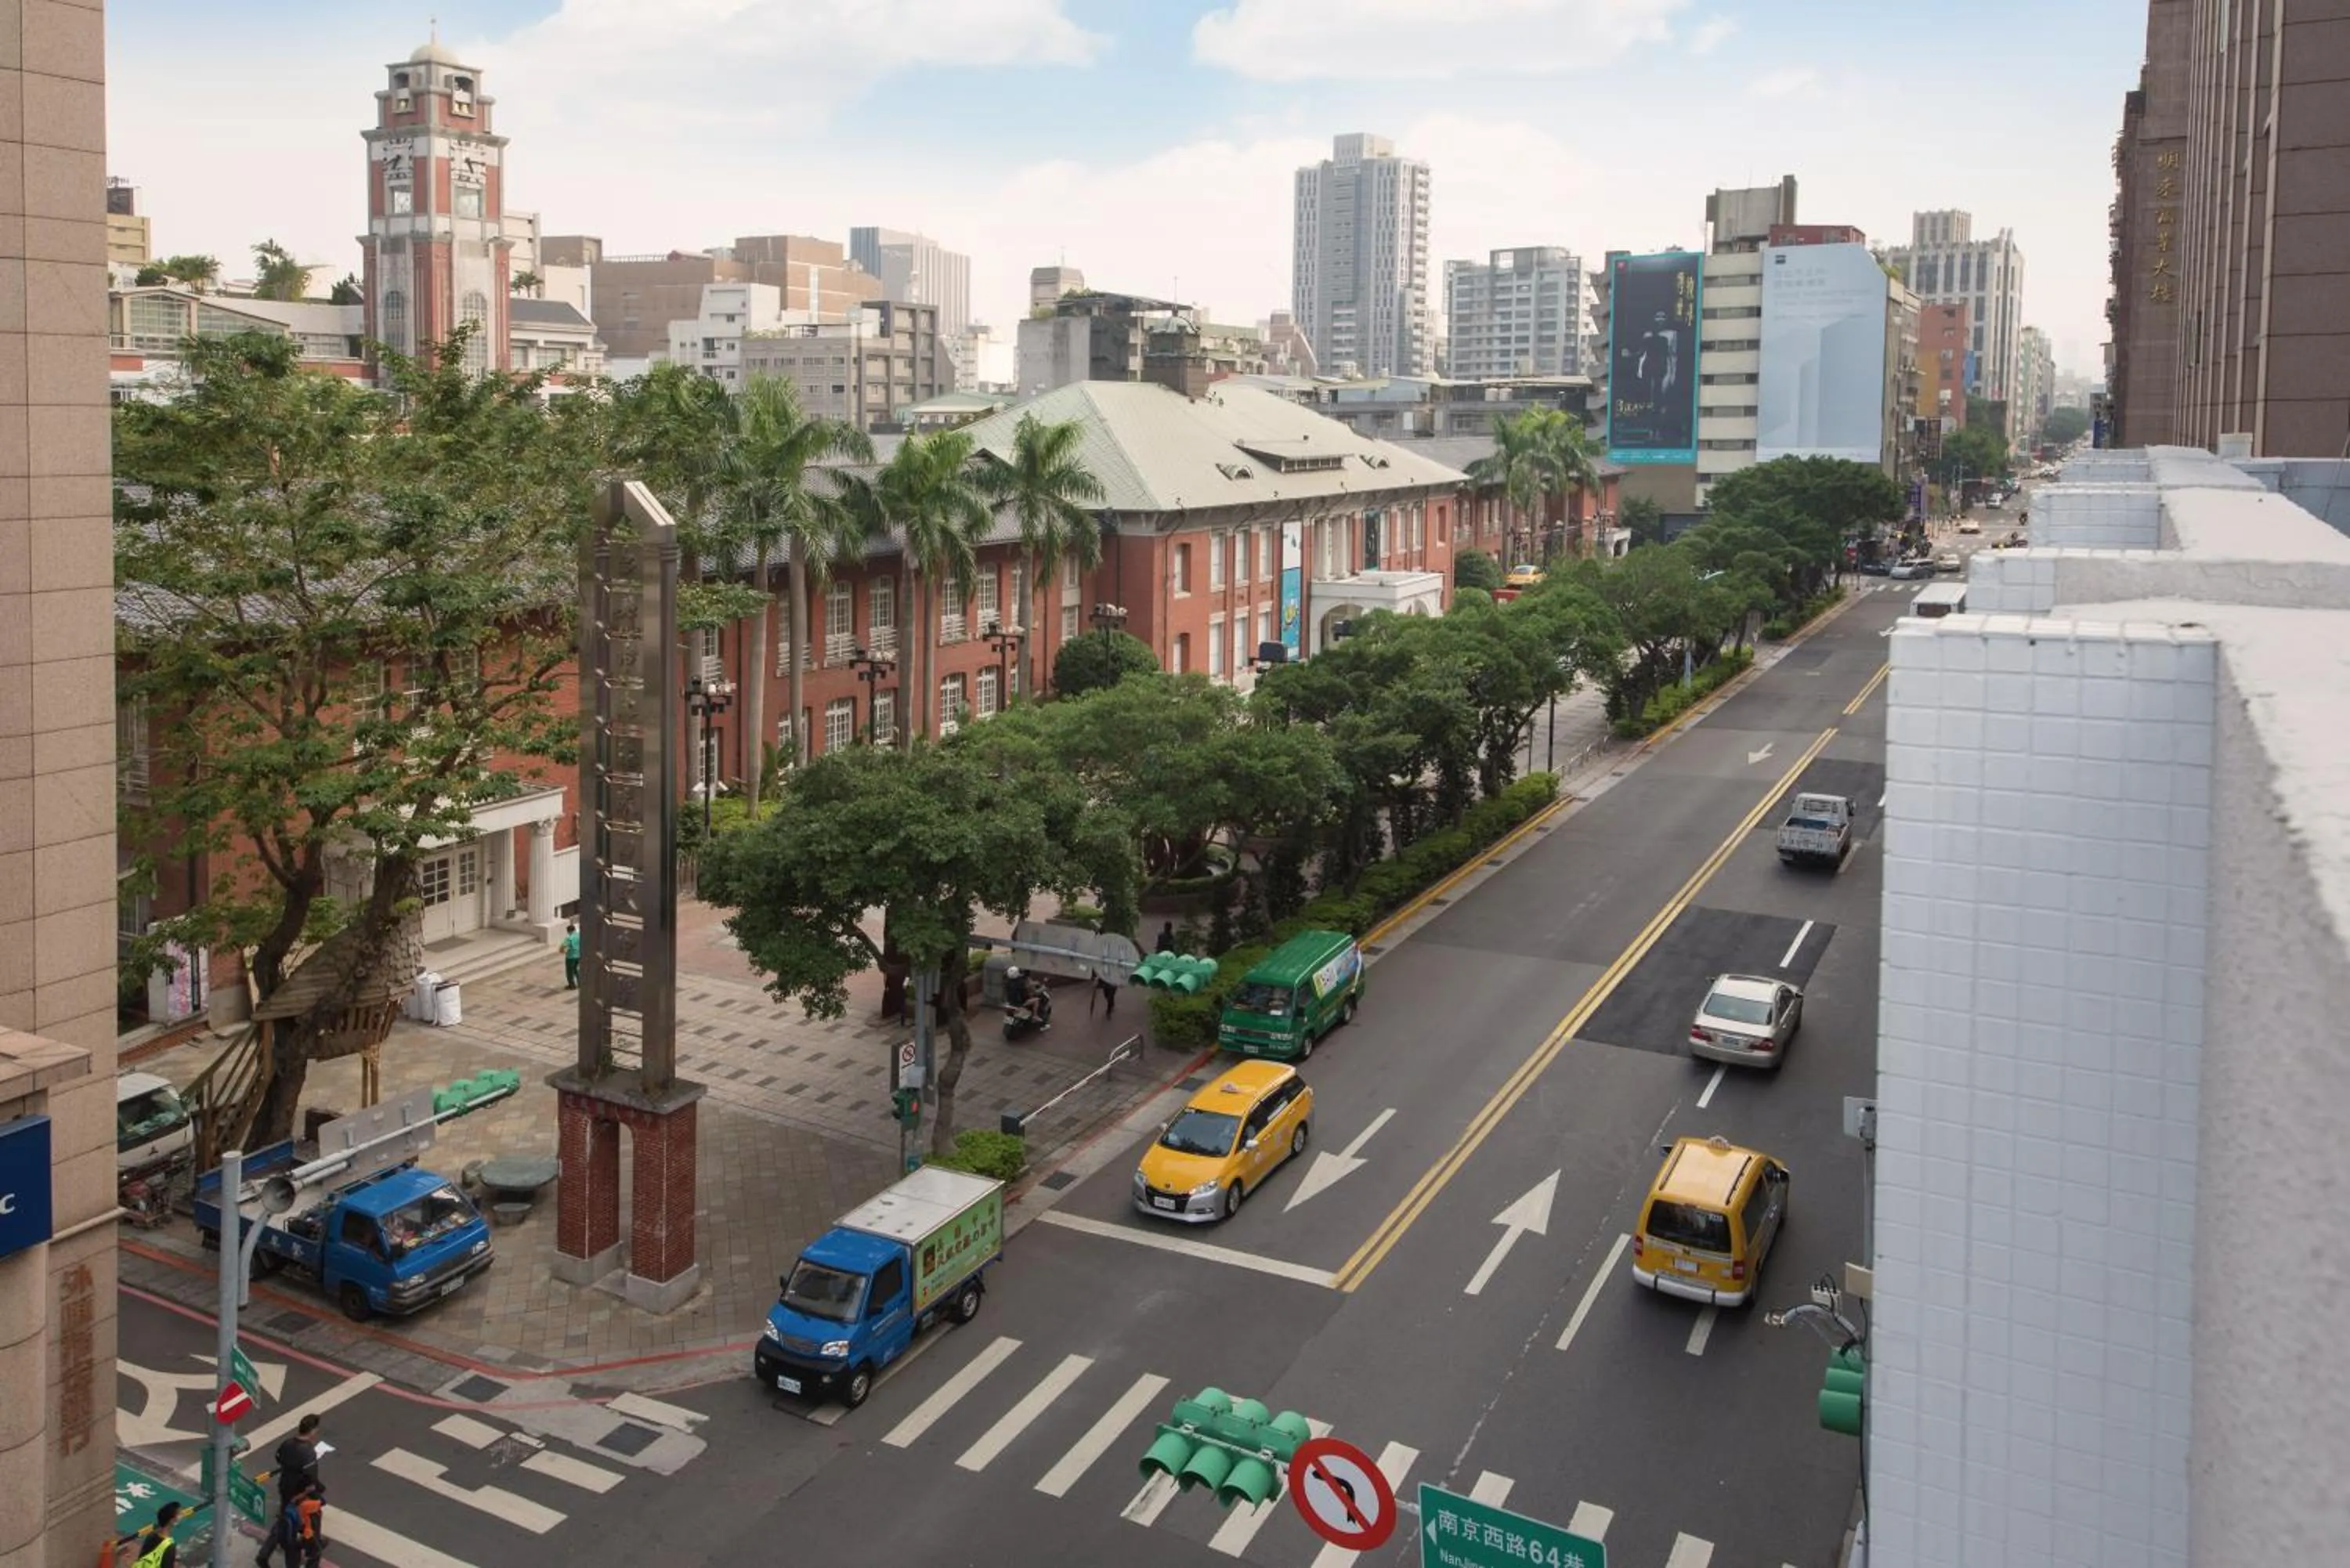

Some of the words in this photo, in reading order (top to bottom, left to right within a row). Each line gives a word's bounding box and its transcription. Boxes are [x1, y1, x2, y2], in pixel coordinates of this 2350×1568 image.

[1438, 1509, 1585, 1568] 南京西路64巷
